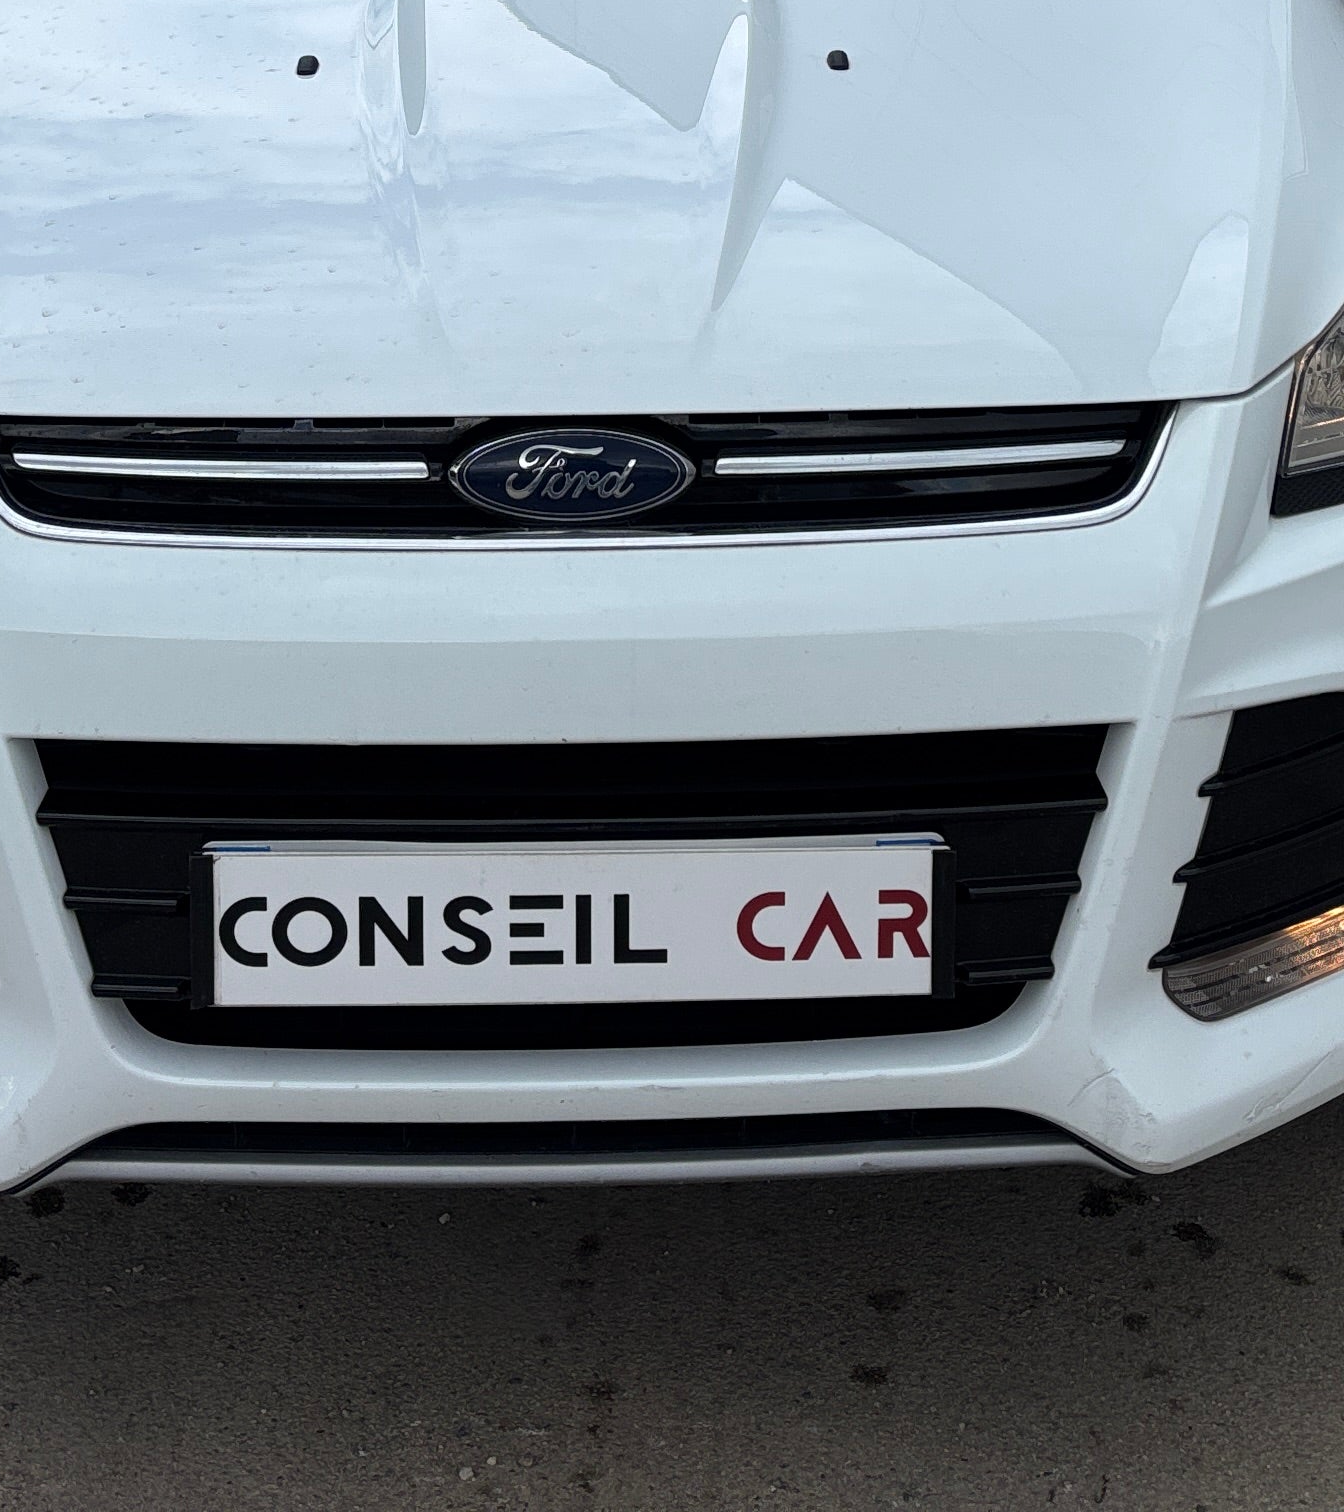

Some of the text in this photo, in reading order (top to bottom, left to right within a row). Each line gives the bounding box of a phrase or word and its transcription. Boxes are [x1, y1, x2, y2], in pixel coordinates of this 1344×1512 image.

[505, 444, 637, 499] Ford
[218, 889, 931, 968] CONSEIL CAR
